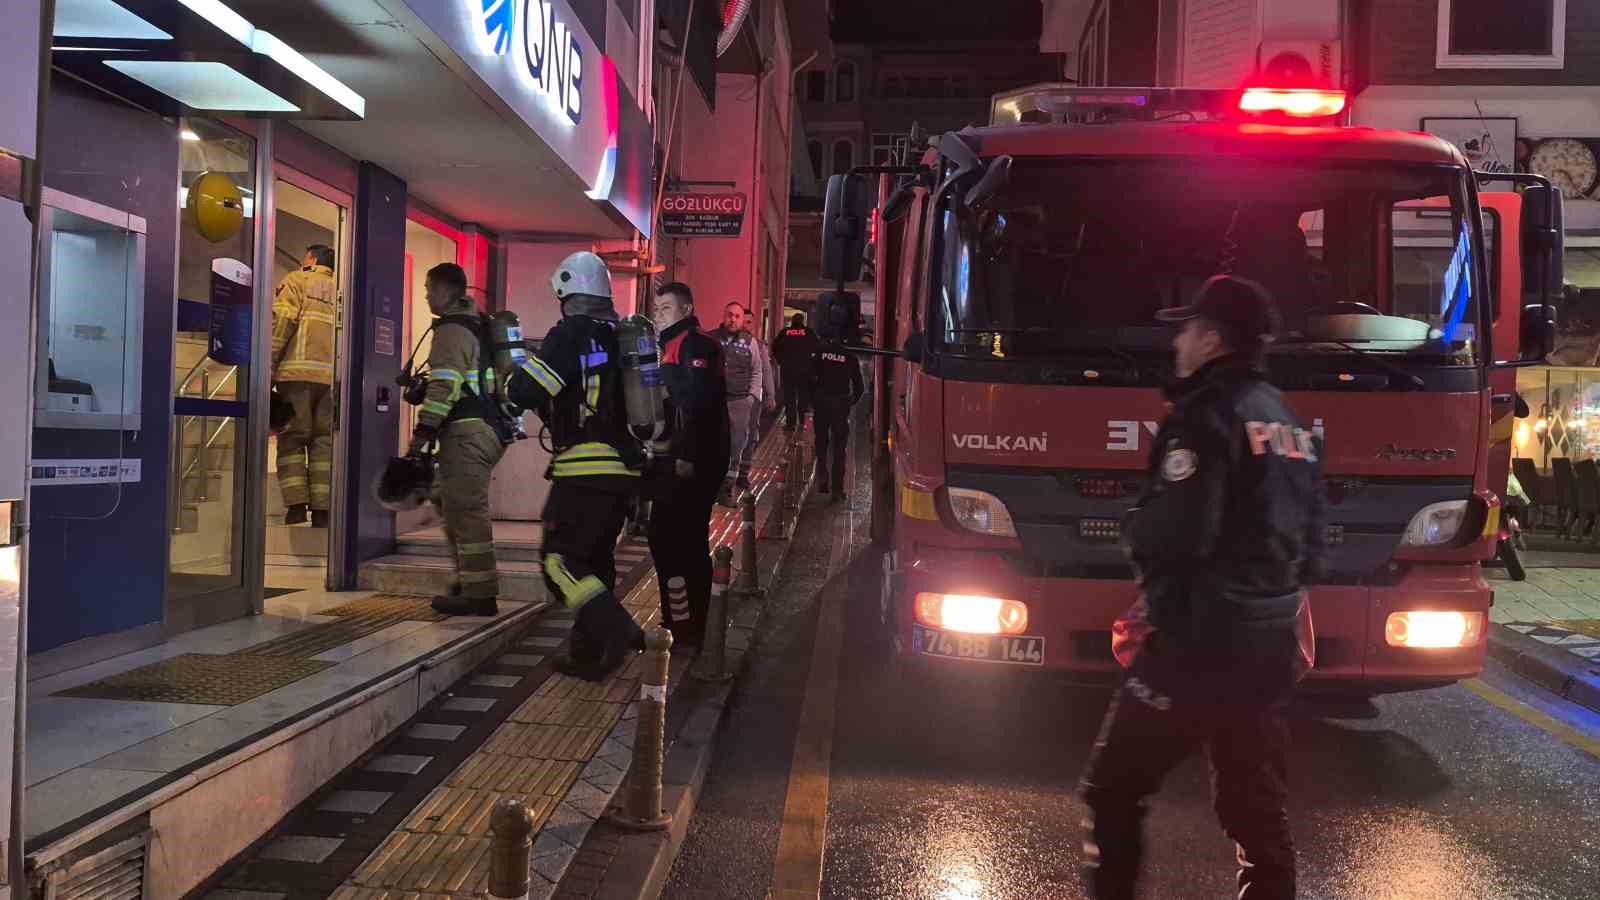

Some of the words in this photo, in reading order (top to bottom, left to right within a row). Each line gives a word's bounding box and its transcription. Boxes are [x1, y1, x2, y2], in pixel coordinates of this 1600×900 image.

[523, 0, 583, 126] QNB
[662, 194, 743, 214] GÖZLÜKÇÜ
[925, 629, 953, 656] 74
[1000, 638, 1041, 663] 144
